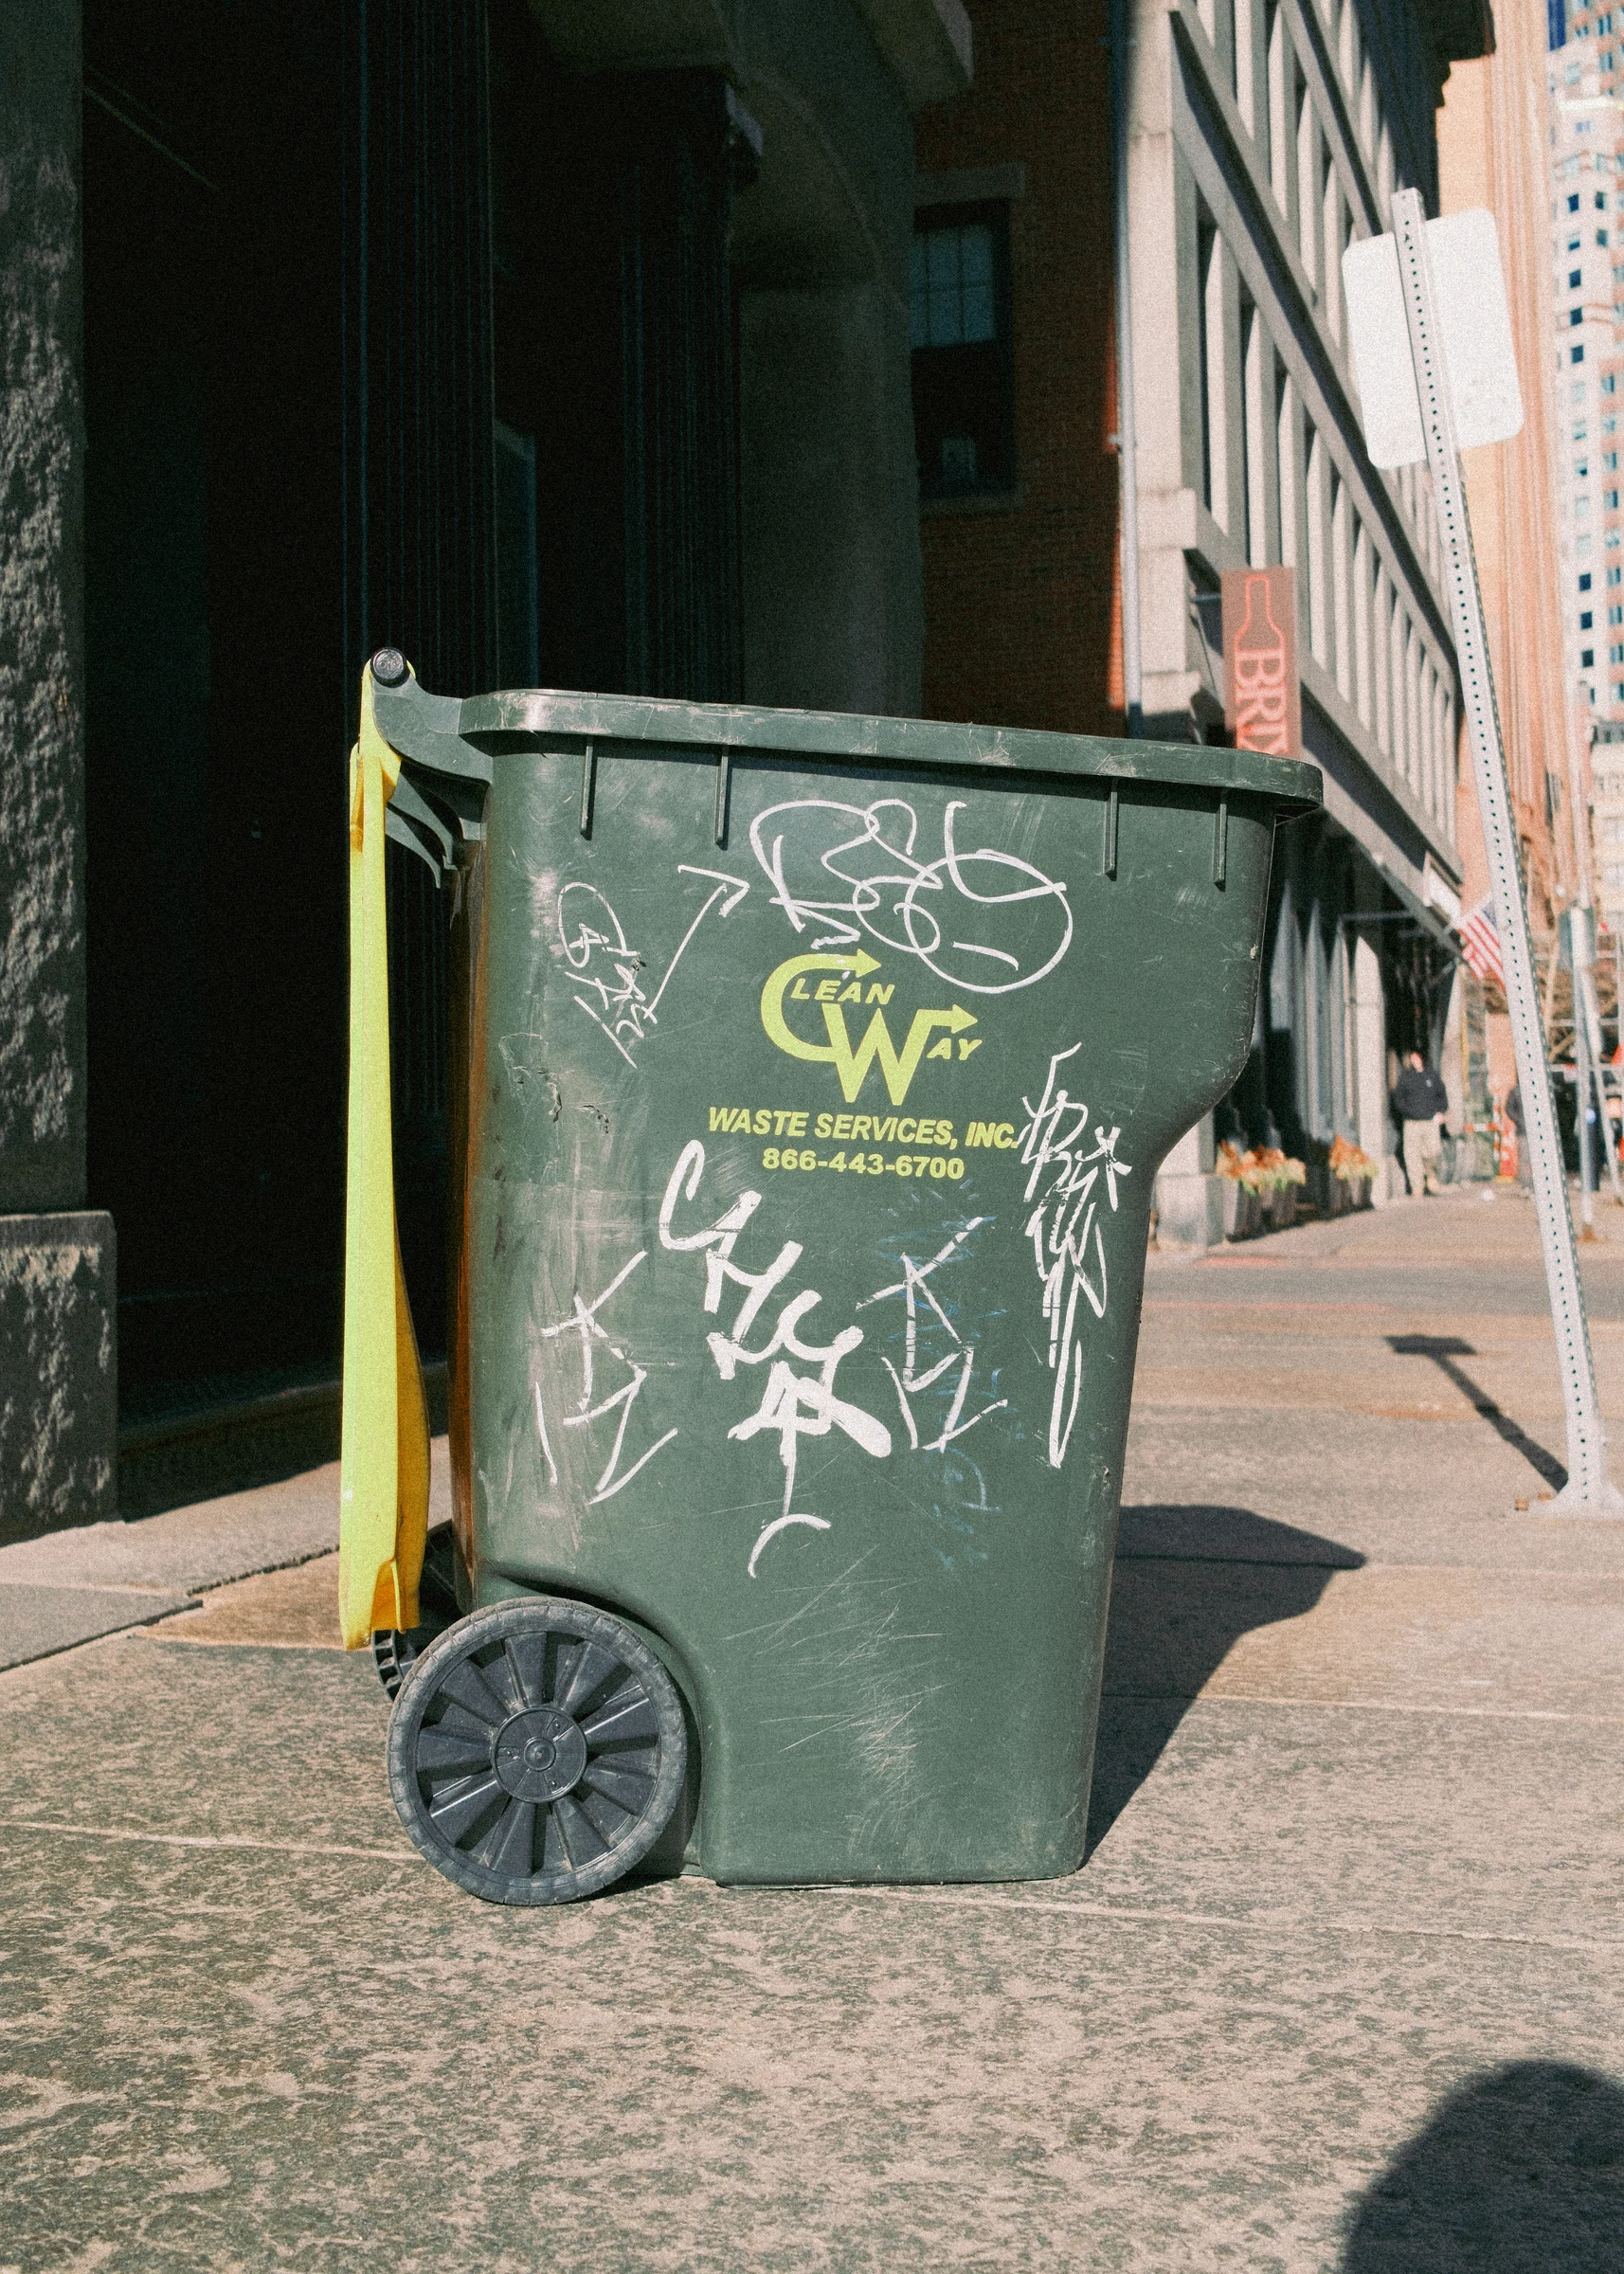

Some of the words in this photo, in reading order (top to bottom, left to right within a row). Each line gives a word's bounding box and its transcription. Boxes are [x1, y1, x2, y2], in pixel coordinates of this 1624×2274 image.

[708, 1107, 810, 1137] WASTE
[814, 1113, 958, 1151] SERVICES,
[964, 1121, 1019, 1150] INC.
[762, 1147, 965, 1181] 866-443-6700
